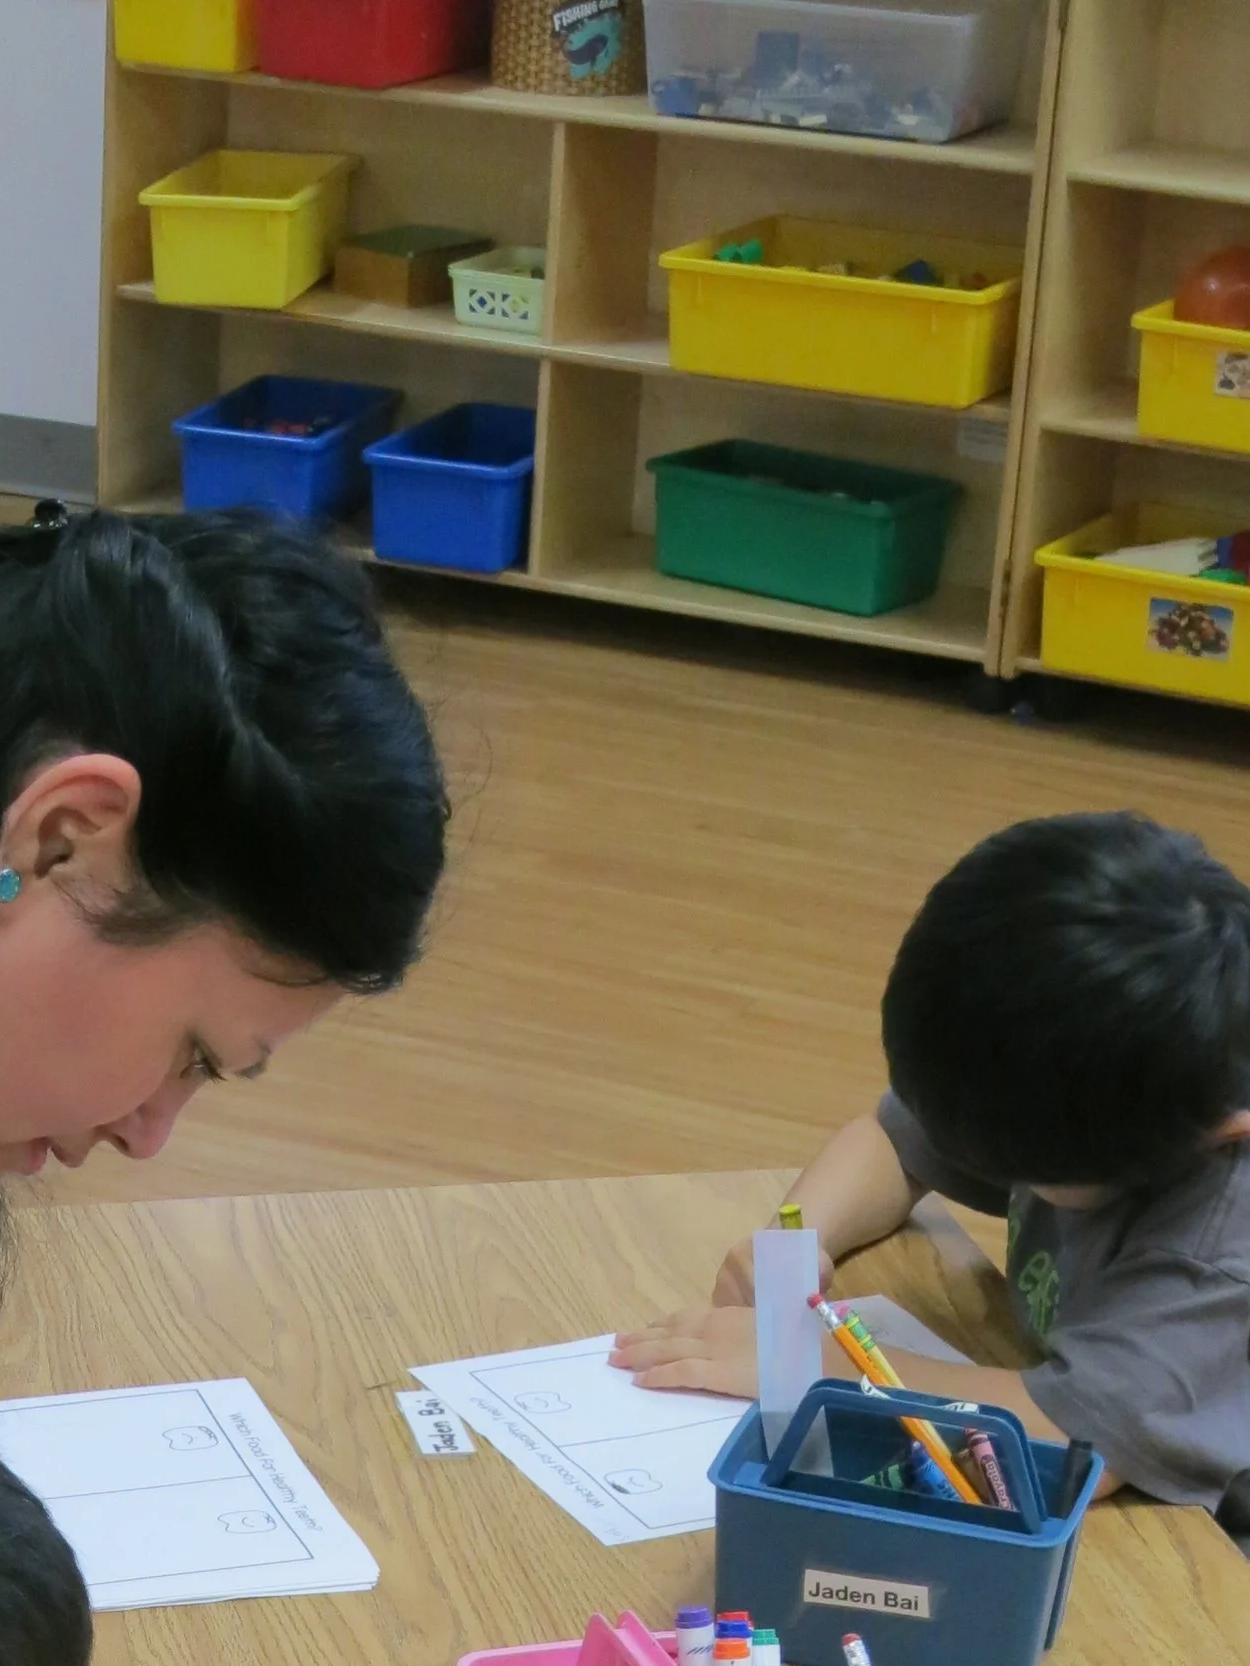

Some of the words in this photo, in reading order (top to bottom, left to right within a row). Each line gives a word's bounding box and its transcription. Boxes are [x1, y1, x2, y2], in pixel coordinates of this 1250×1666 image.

[415, 1398, 445, 1416] Bai
[428, 1420, 459, 1452] Jaden
[504, 1421, 540, 1451] Healthy
[230, 1412, 251, 1437] Which
[245, 1436, 270, 1457] Food
[259, 1458, 276, 1473] For
[269, 1473, 297, 1503] Healthy
[536, 1450, 555, 1467] For
[551, 1464, 578, 1486] Food
[575, 1484, 605, 1508] Which
[808, 1582, 876, 1605] Jaden
[883, 1591, 919, 1611] Bai
